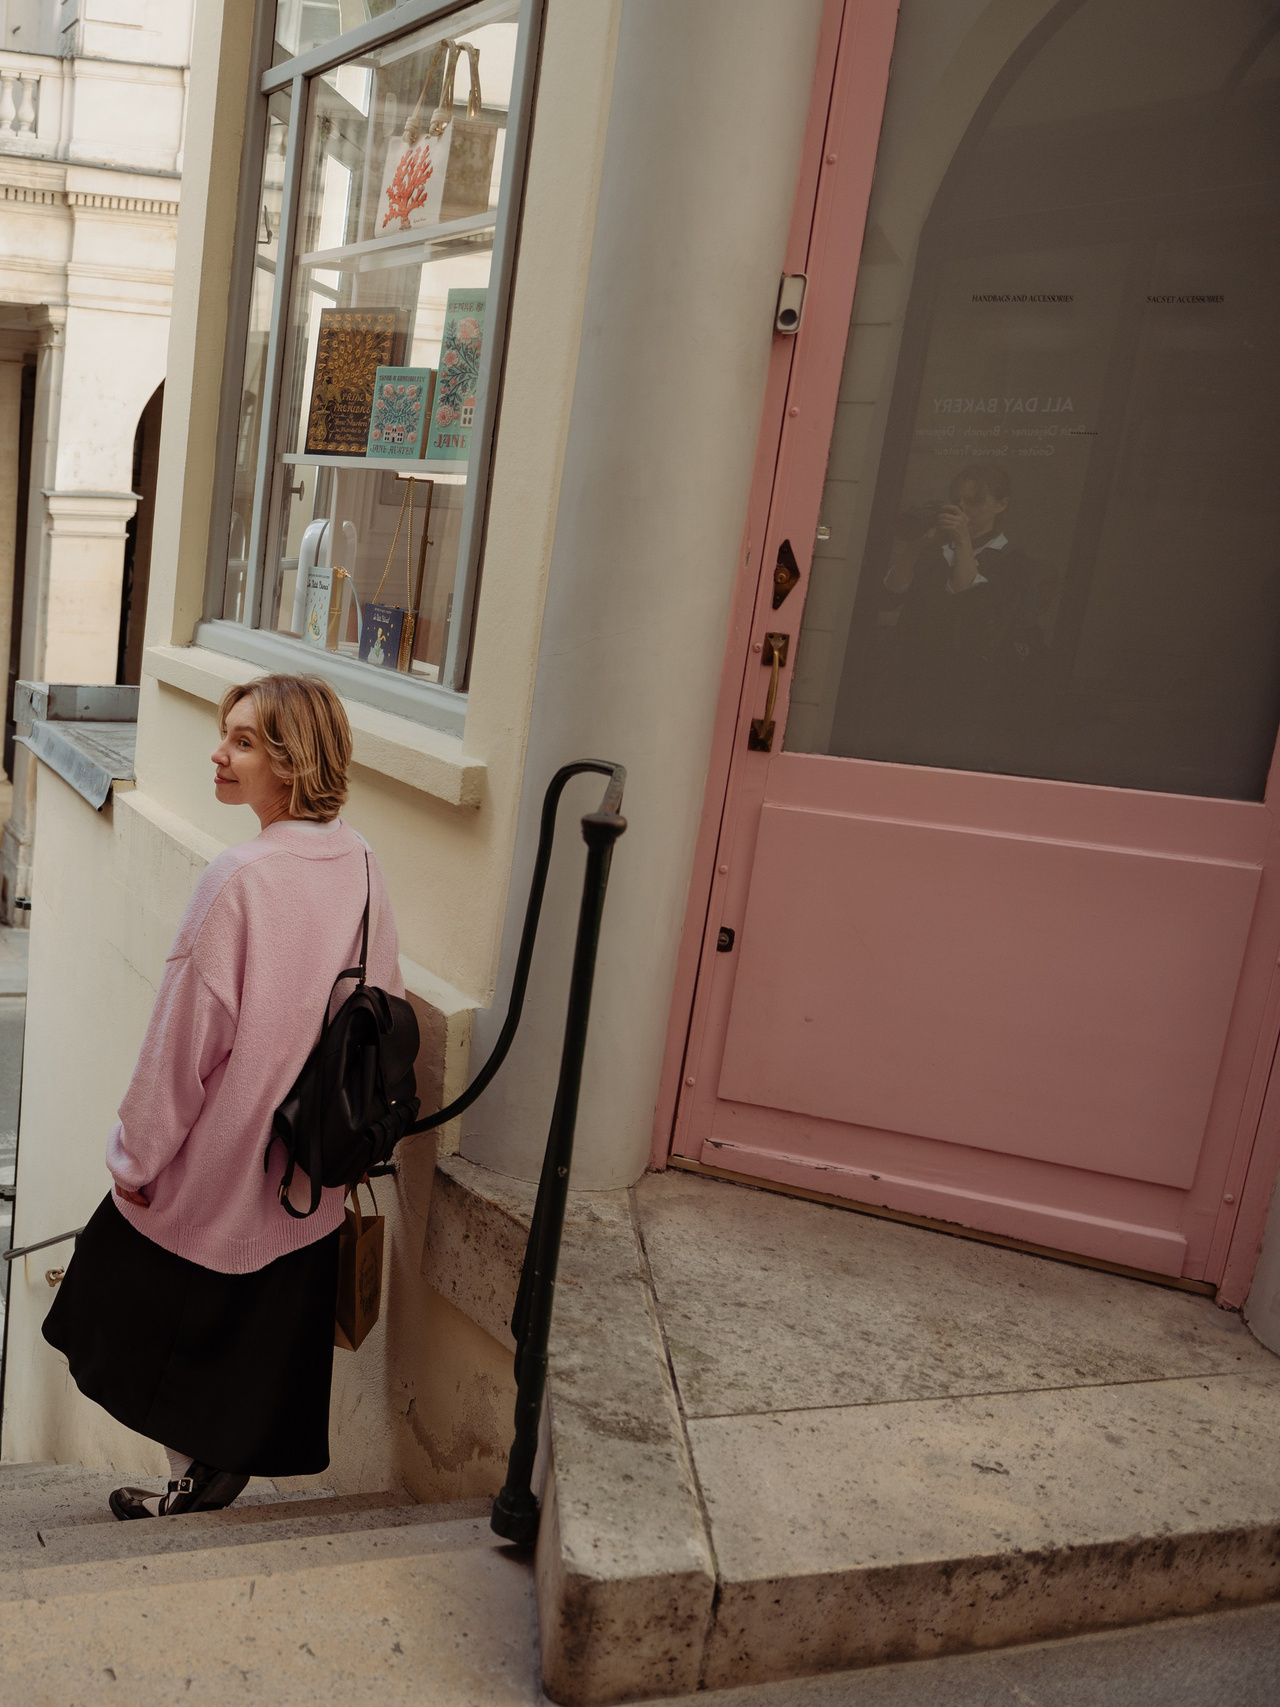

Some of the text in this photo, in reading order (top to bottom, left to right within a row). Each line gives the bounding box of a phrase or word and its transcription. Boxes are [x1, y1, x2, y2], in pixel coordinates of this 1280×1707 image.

[972, 294, 1011, 302] HANDBAGS
[1146, 295, 1225, 303] SACS ET ACCESSOIRES
[448, 302, 474, 313] SENSE
[341, 393, 365, 402] PRIDE
[333, 403, 371, 414] PREJUDICE
[433, 434, 467, 448] JANE
[370, 445, 414, 455] JANE AUSTEN
